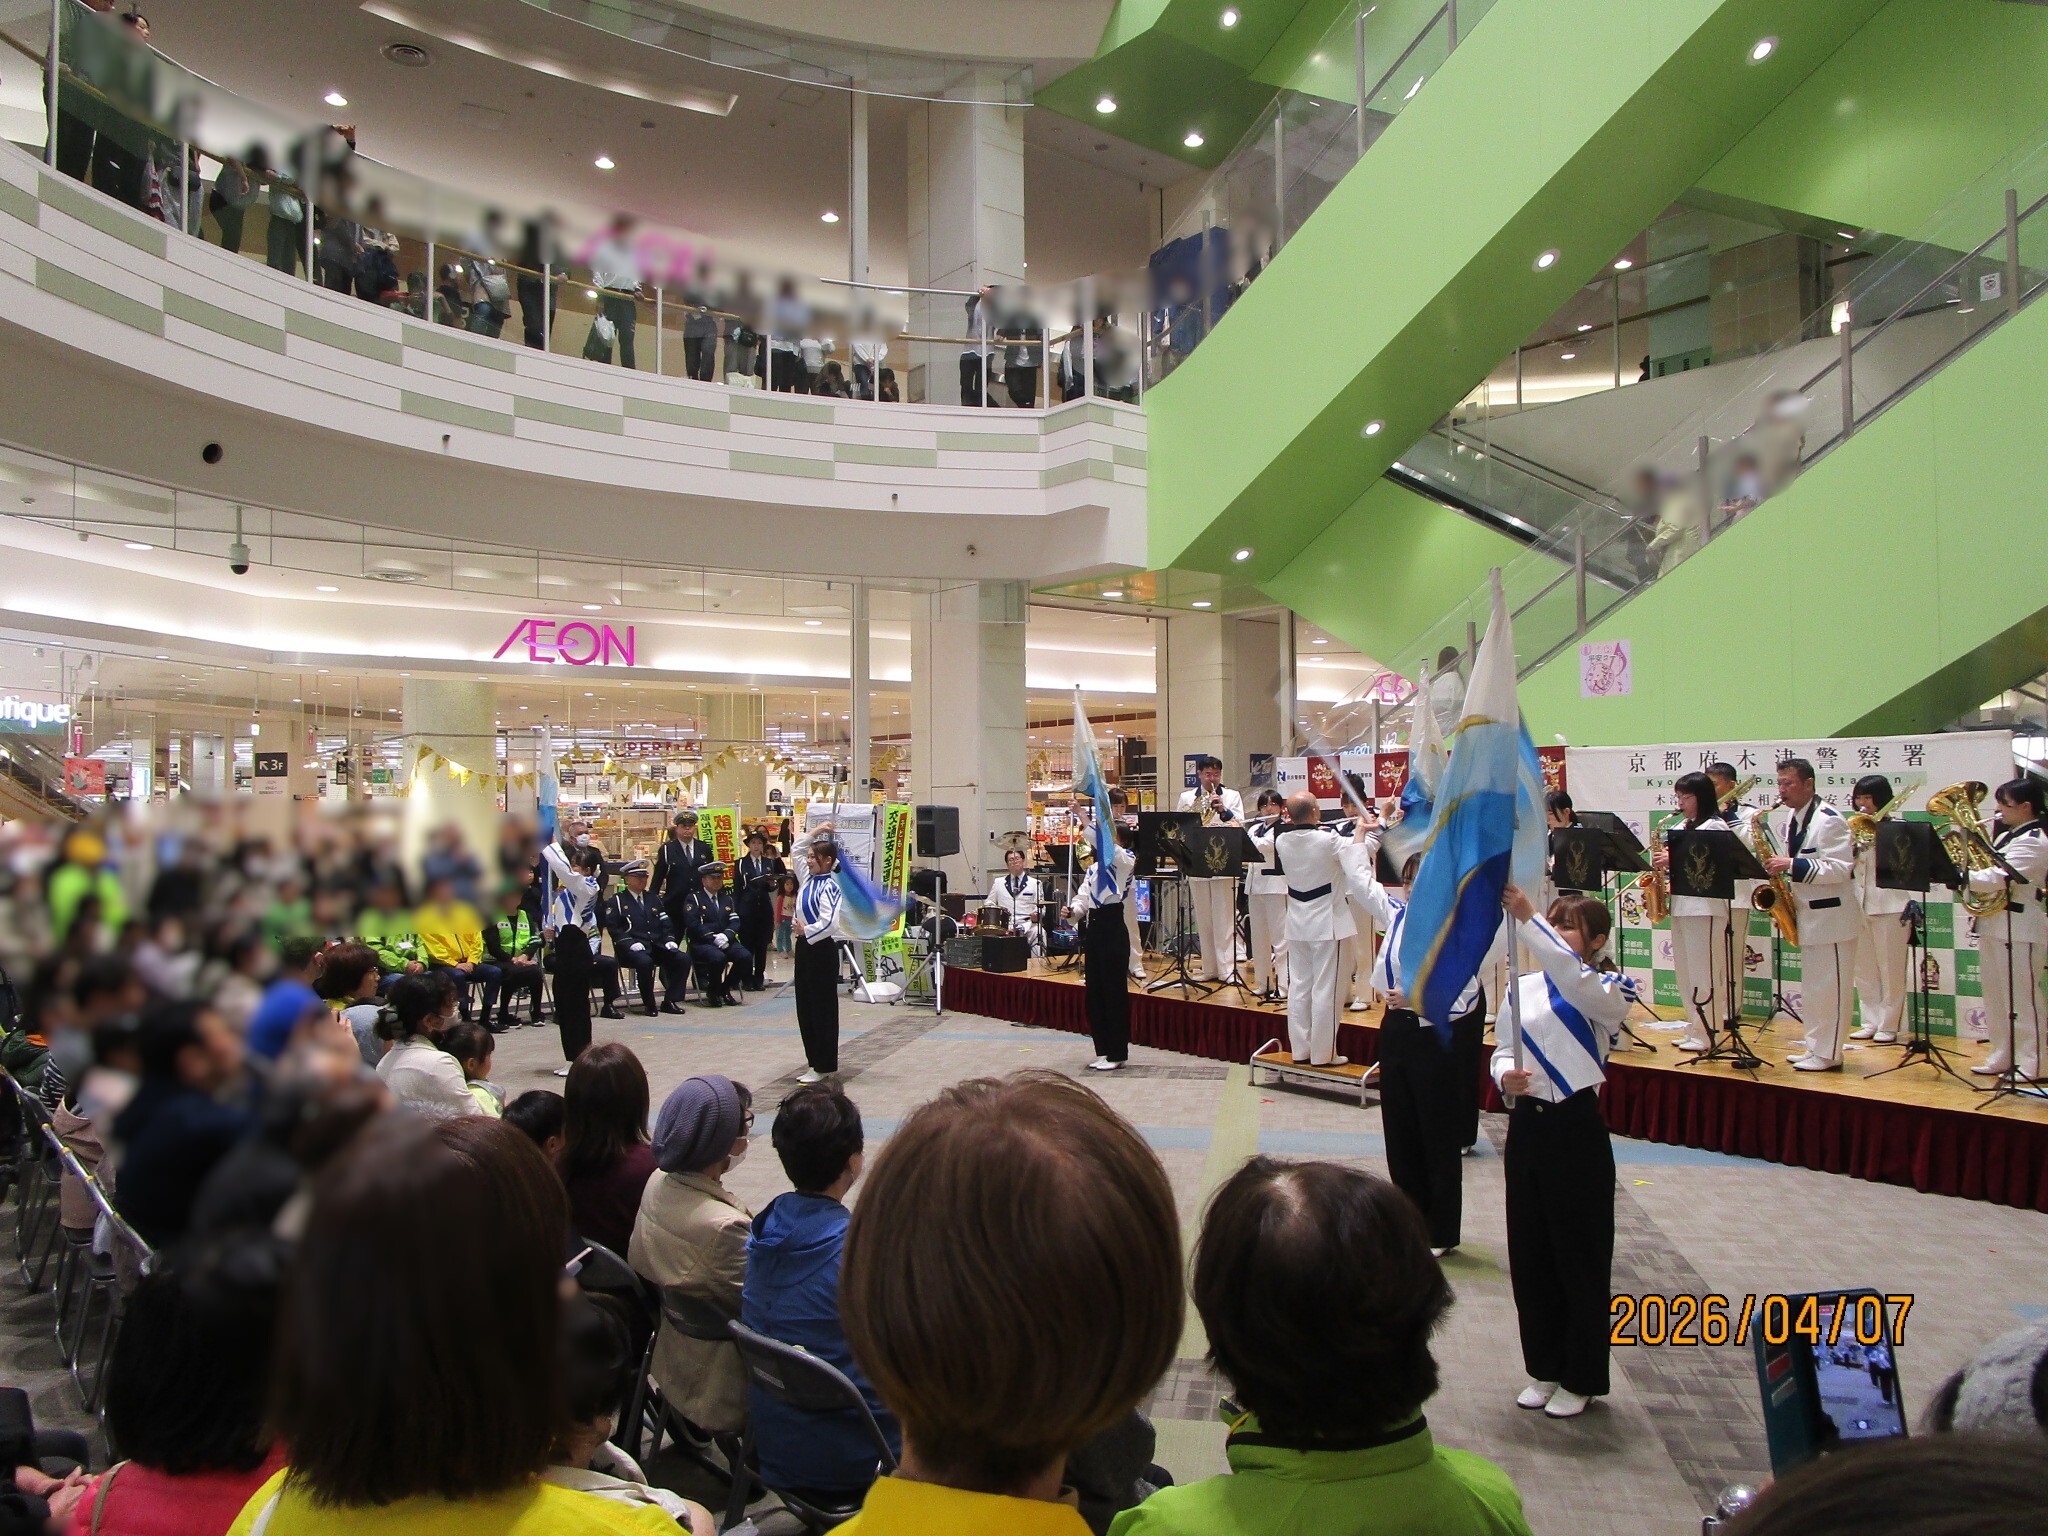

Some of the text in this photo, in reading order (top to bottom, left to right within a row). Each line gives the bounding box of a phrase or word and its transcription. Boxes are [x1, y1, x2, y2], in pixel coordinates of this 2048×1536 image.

[0, 695, 71, 728] tique
[270, 759, 284, 771] 3F
[1627, 743, 1926, 773] 京都府木津警察署
